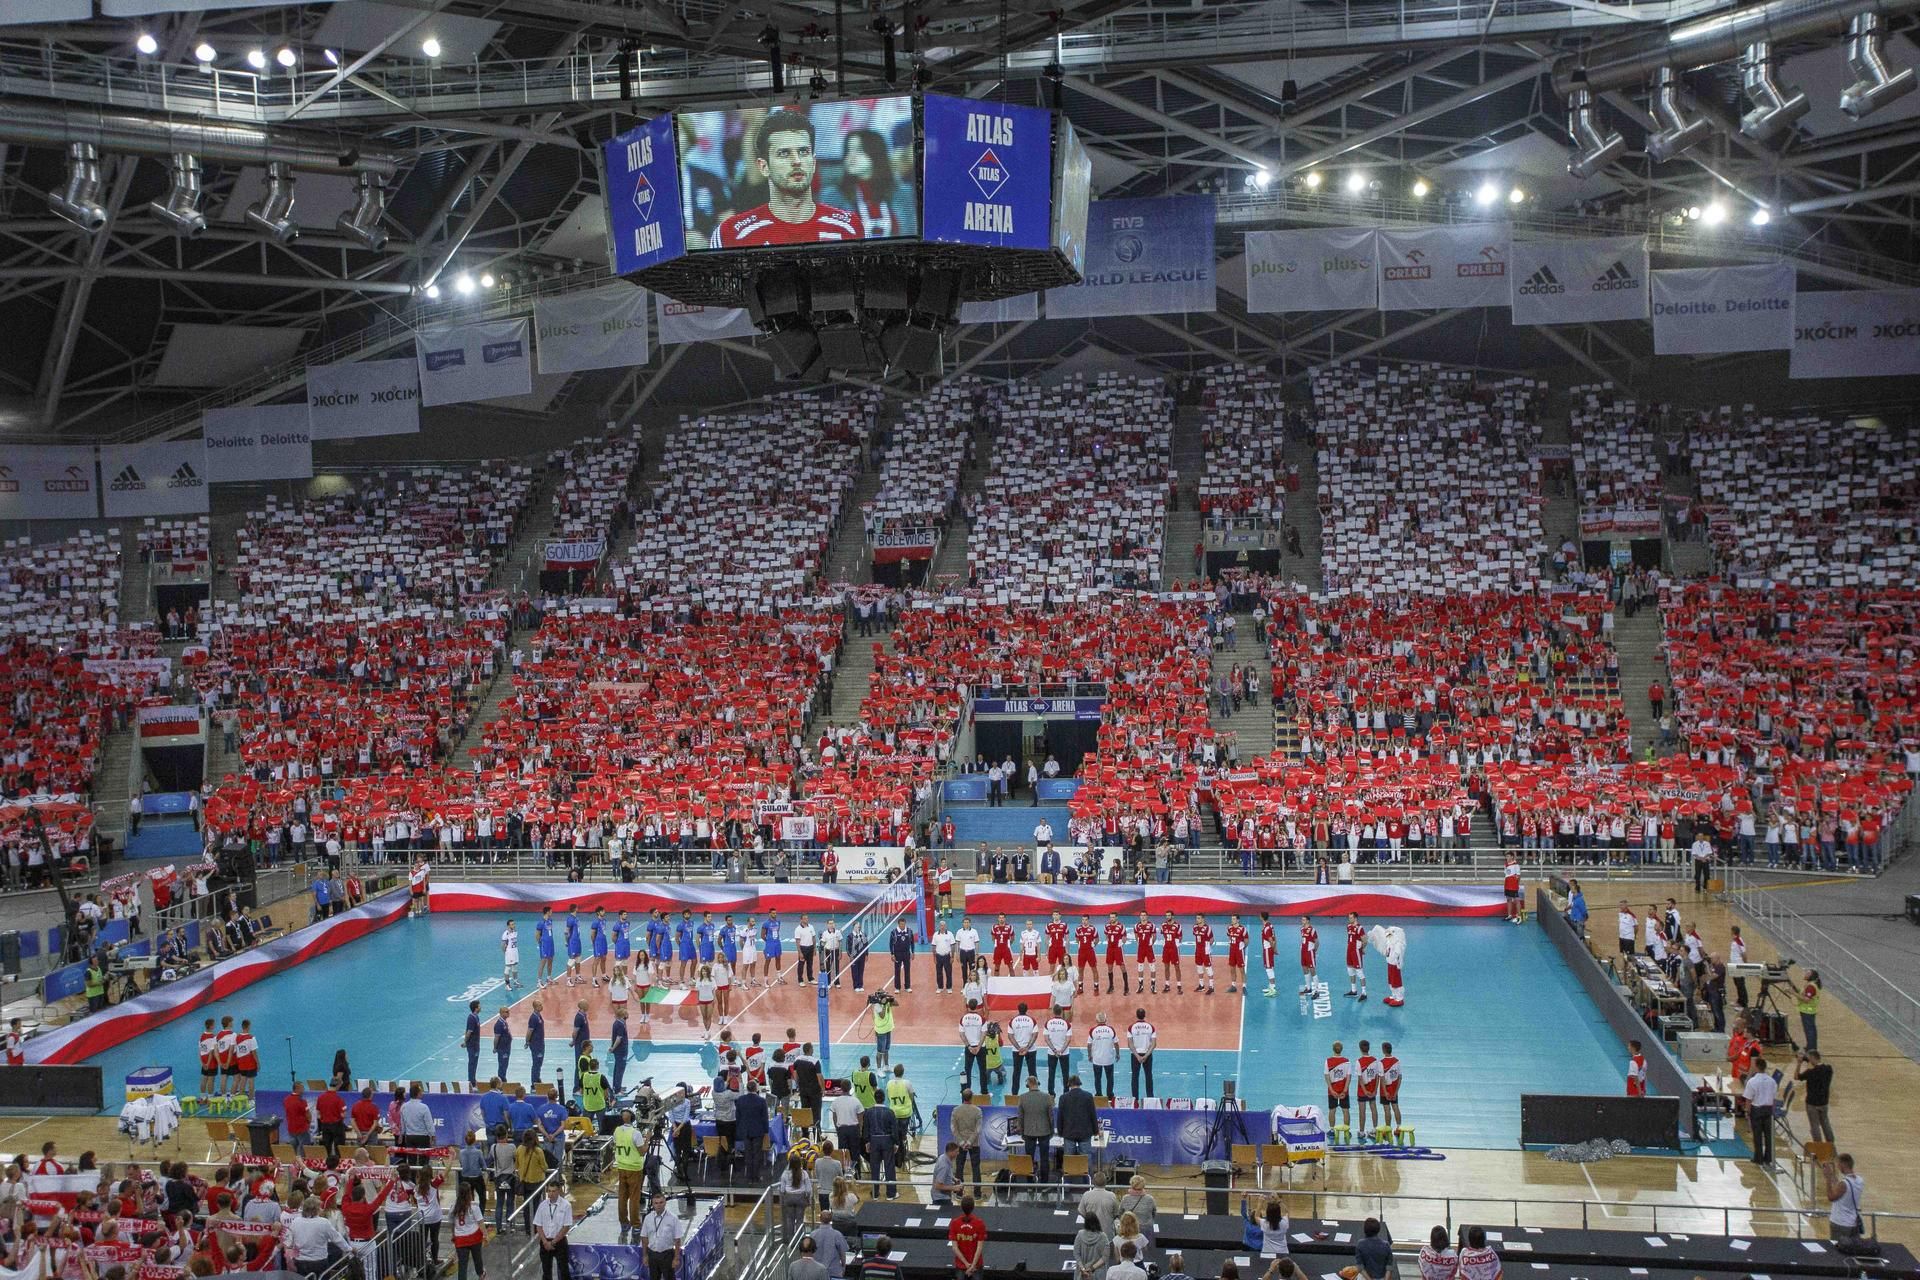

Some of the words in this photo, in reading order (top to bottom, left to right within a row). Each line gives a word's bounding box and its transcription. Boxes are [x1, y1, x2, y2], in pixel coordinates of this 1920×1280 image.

[966, 113, 1013, 147] ATLAS
[627, 135, 654, 173] ATLAS
[977, 167, 1000, 182] ATLAS
[963, 202, 1014, 234] ARENA
[1112, 216, 1144, 230] FIVB
[635, 221, 664, 257] ARENA
[1252, 258, 1286, 277] plus
[1323, 255, 1359, 275] plus
[1385, 267, 1430, 280] ORLEN
[1458, 262, 1504, 277] ORLEN
[1129, 268, 1209, 284] LEAGUE
[1519, 283, 1566, 296] adidas
[1592, 279, 1639, 292] adidas
[1654, 302, 1716, 316] Deloitte
[1726, 298, 1790, 313] Deloitte
[206, 437, 254, 448] Deloitte
[261, 434, 309, 445] Deloitte
[110, 480, 146, 491] adidas
[167, 478, 203, 488] adidas
[878, 533, 931, 547] BOLEWICE
[1004, 701, 1028, 712] ATLAS
[1051, 700, 1076, 712] ARENA
[585, 1087, 598, 1096] TV
[854, 1084, 867, 1094] TV
[890, 1096, 906, 1106] TV
[615, 1145, 631, 1157] TV
[1421, 1250, 1456, 1265] POLSKA
[1463, 1253, 1497, 1265] POLSKA
